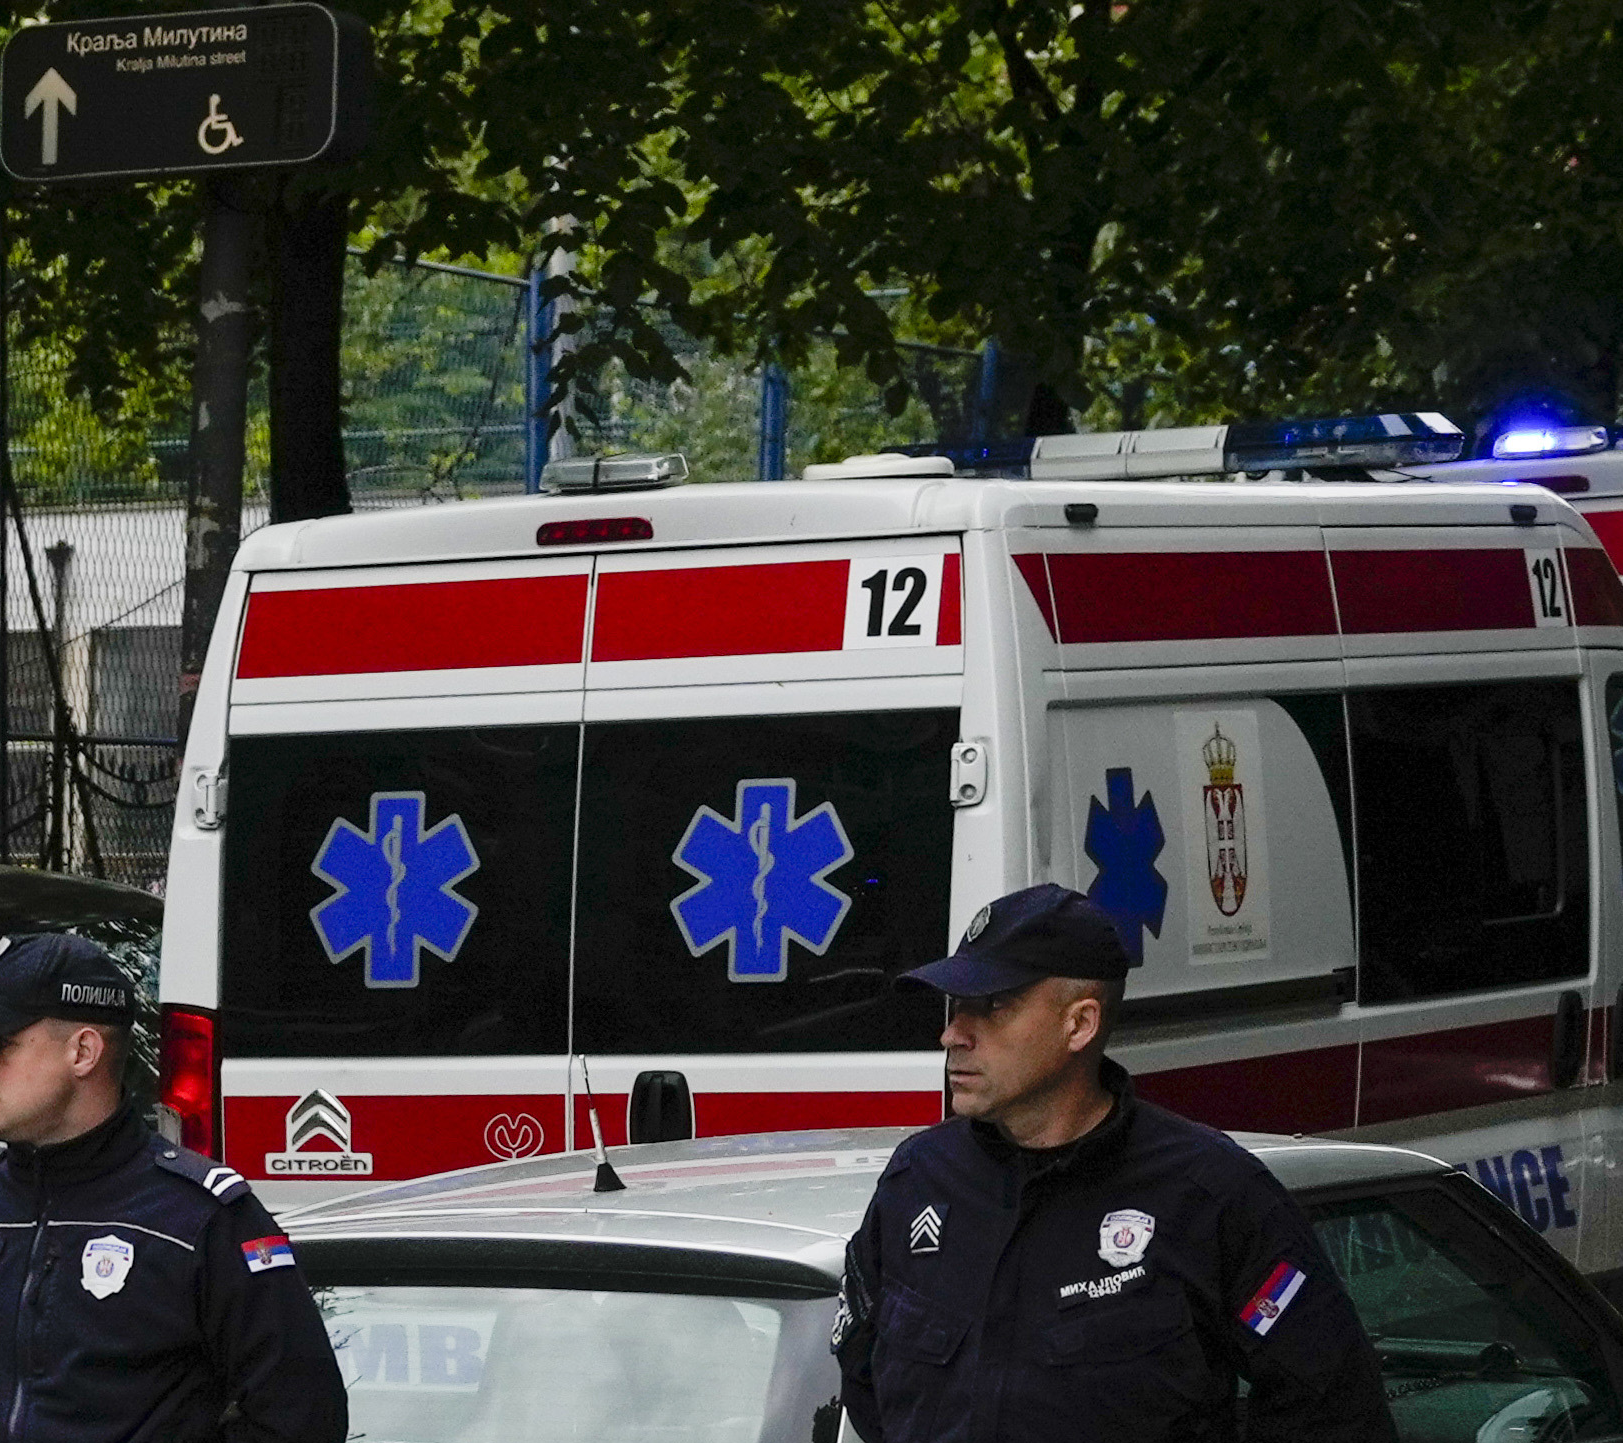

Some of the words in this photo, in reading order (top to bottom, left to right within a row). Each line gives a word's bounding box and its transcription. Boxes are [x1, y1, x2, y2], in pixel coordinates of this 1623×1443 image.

[66, 32, 138, 57] Краља
[143, 24, 248, 50] Милутина
[861, 566, 927, 637] 12
[1531, 556, 1563, 619] 12
[61, 983, 127, 1007] ПОЛИЦИЈА
[271, 1154, 368, 1172] CITROËN
[1059, 1265, 1147, 1299] МИХАЈЛОВИЋ
